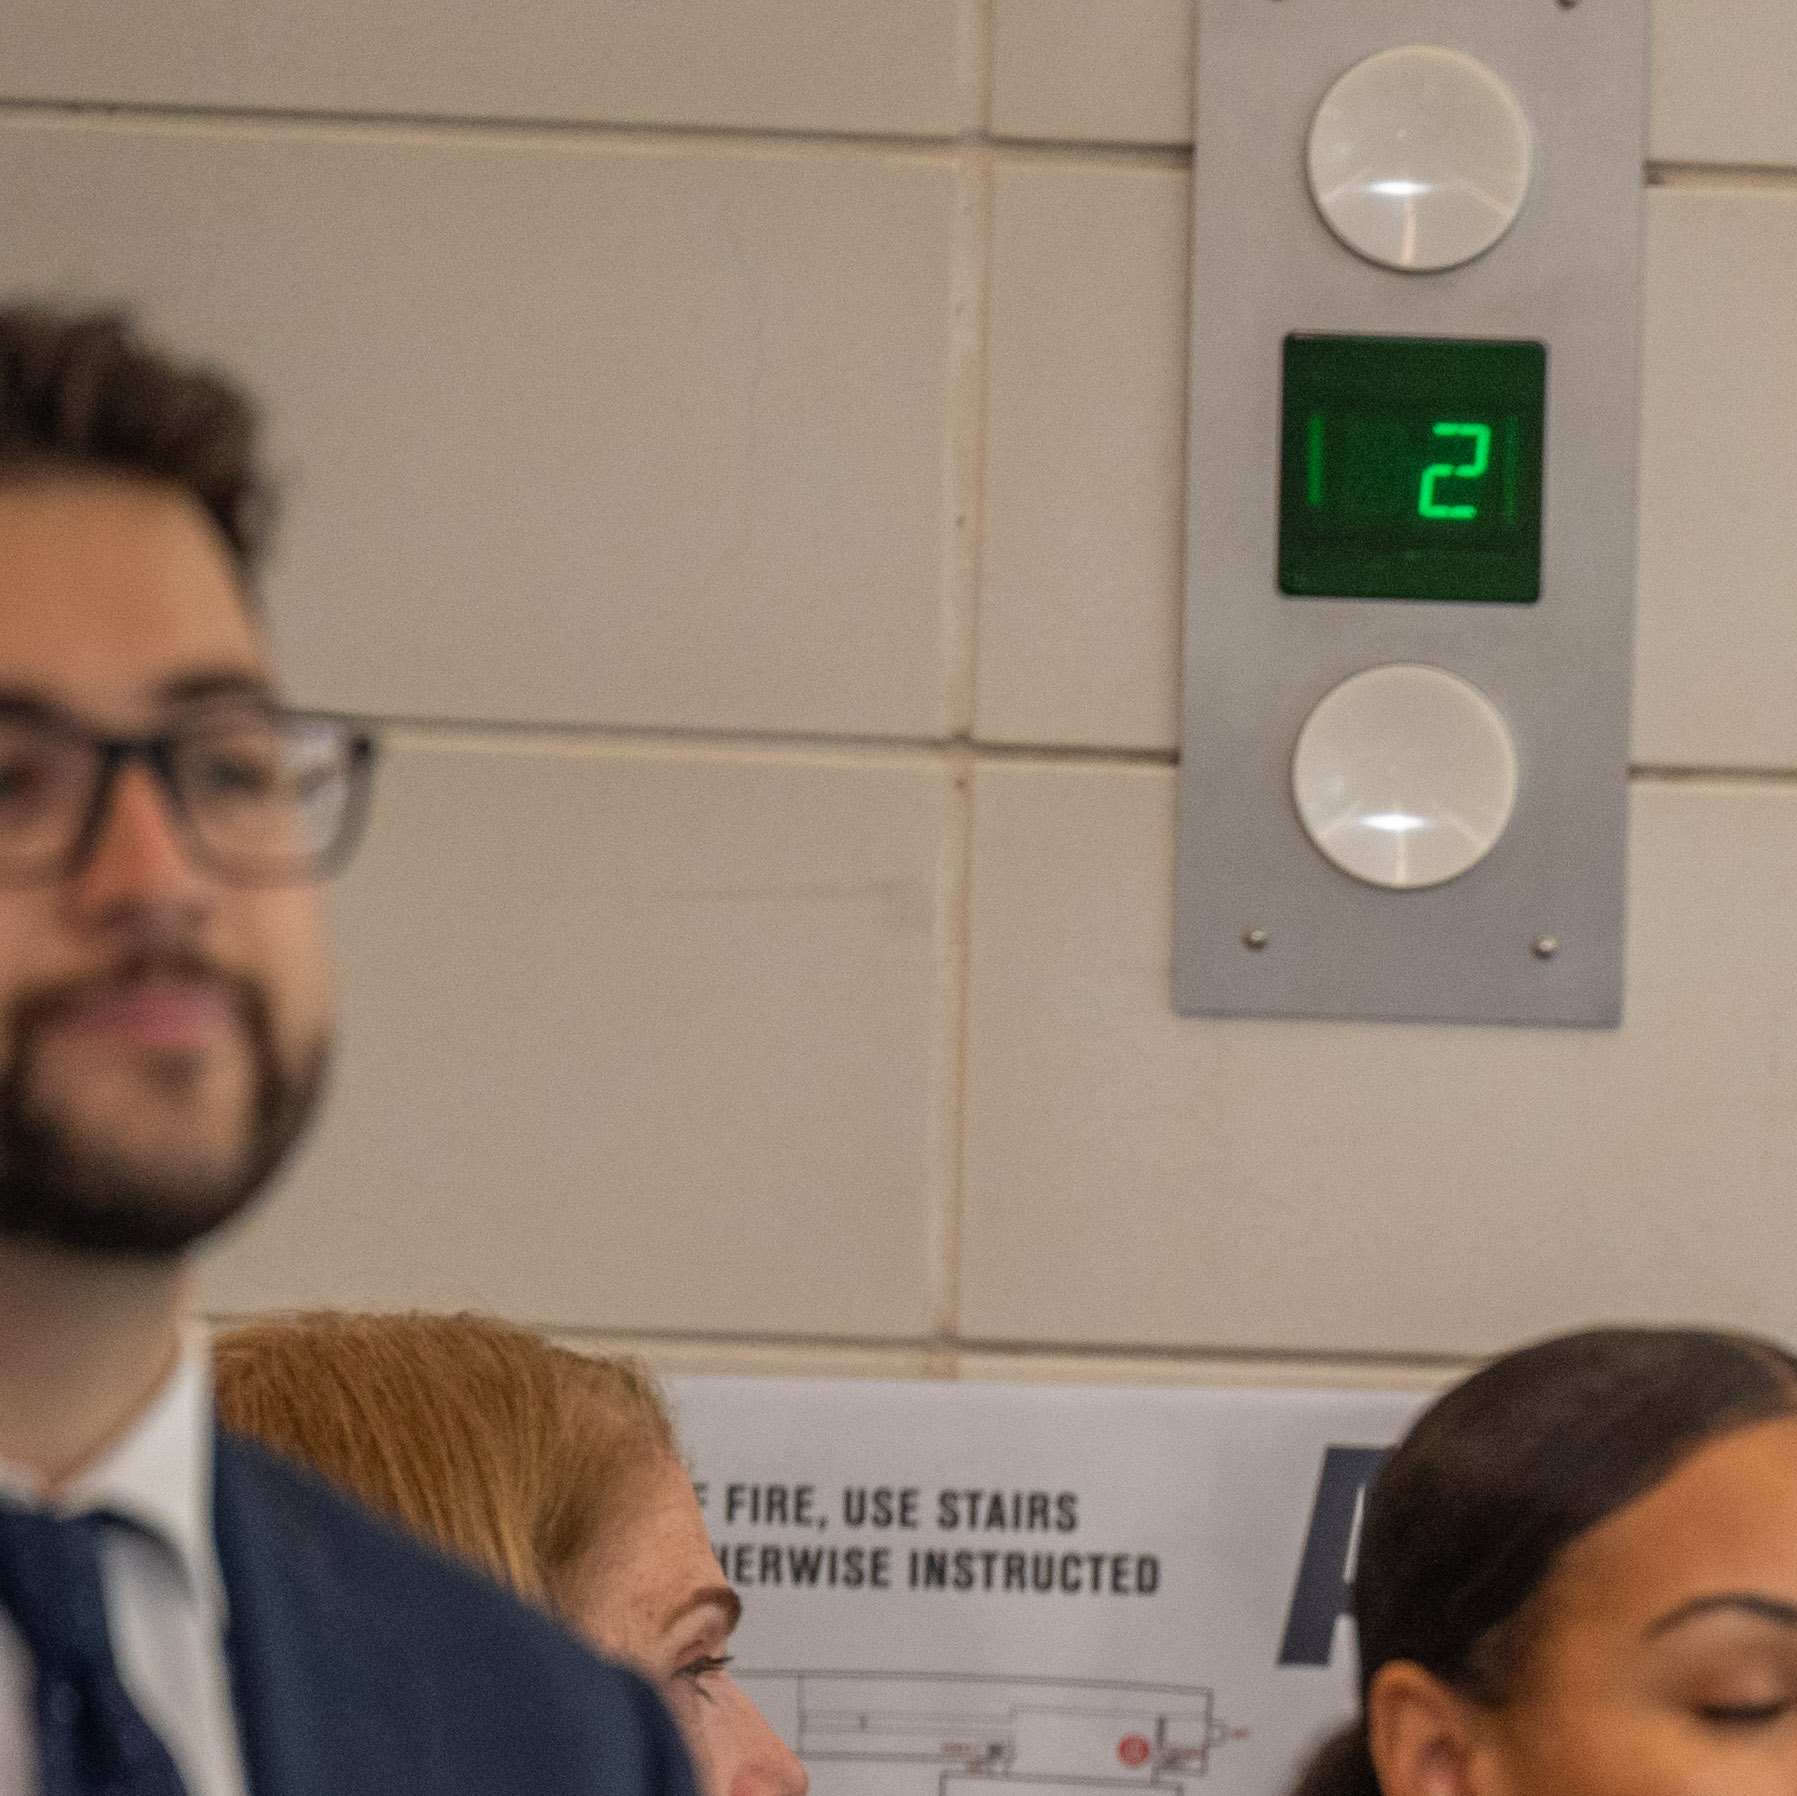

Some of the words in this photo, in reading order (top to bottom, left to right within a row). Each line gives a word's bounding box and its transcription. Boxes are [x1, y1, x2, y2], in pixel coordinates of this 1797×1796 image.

[1418, 423, 1489, 520] 2
[725, 1483, 828, 1533] FIRE,
[843, 1485, 919, 1529] USE
[937, 1488, 1078, 1533] STAIRS
[908, 1550, 1160, 1594] INSTRUCTED
